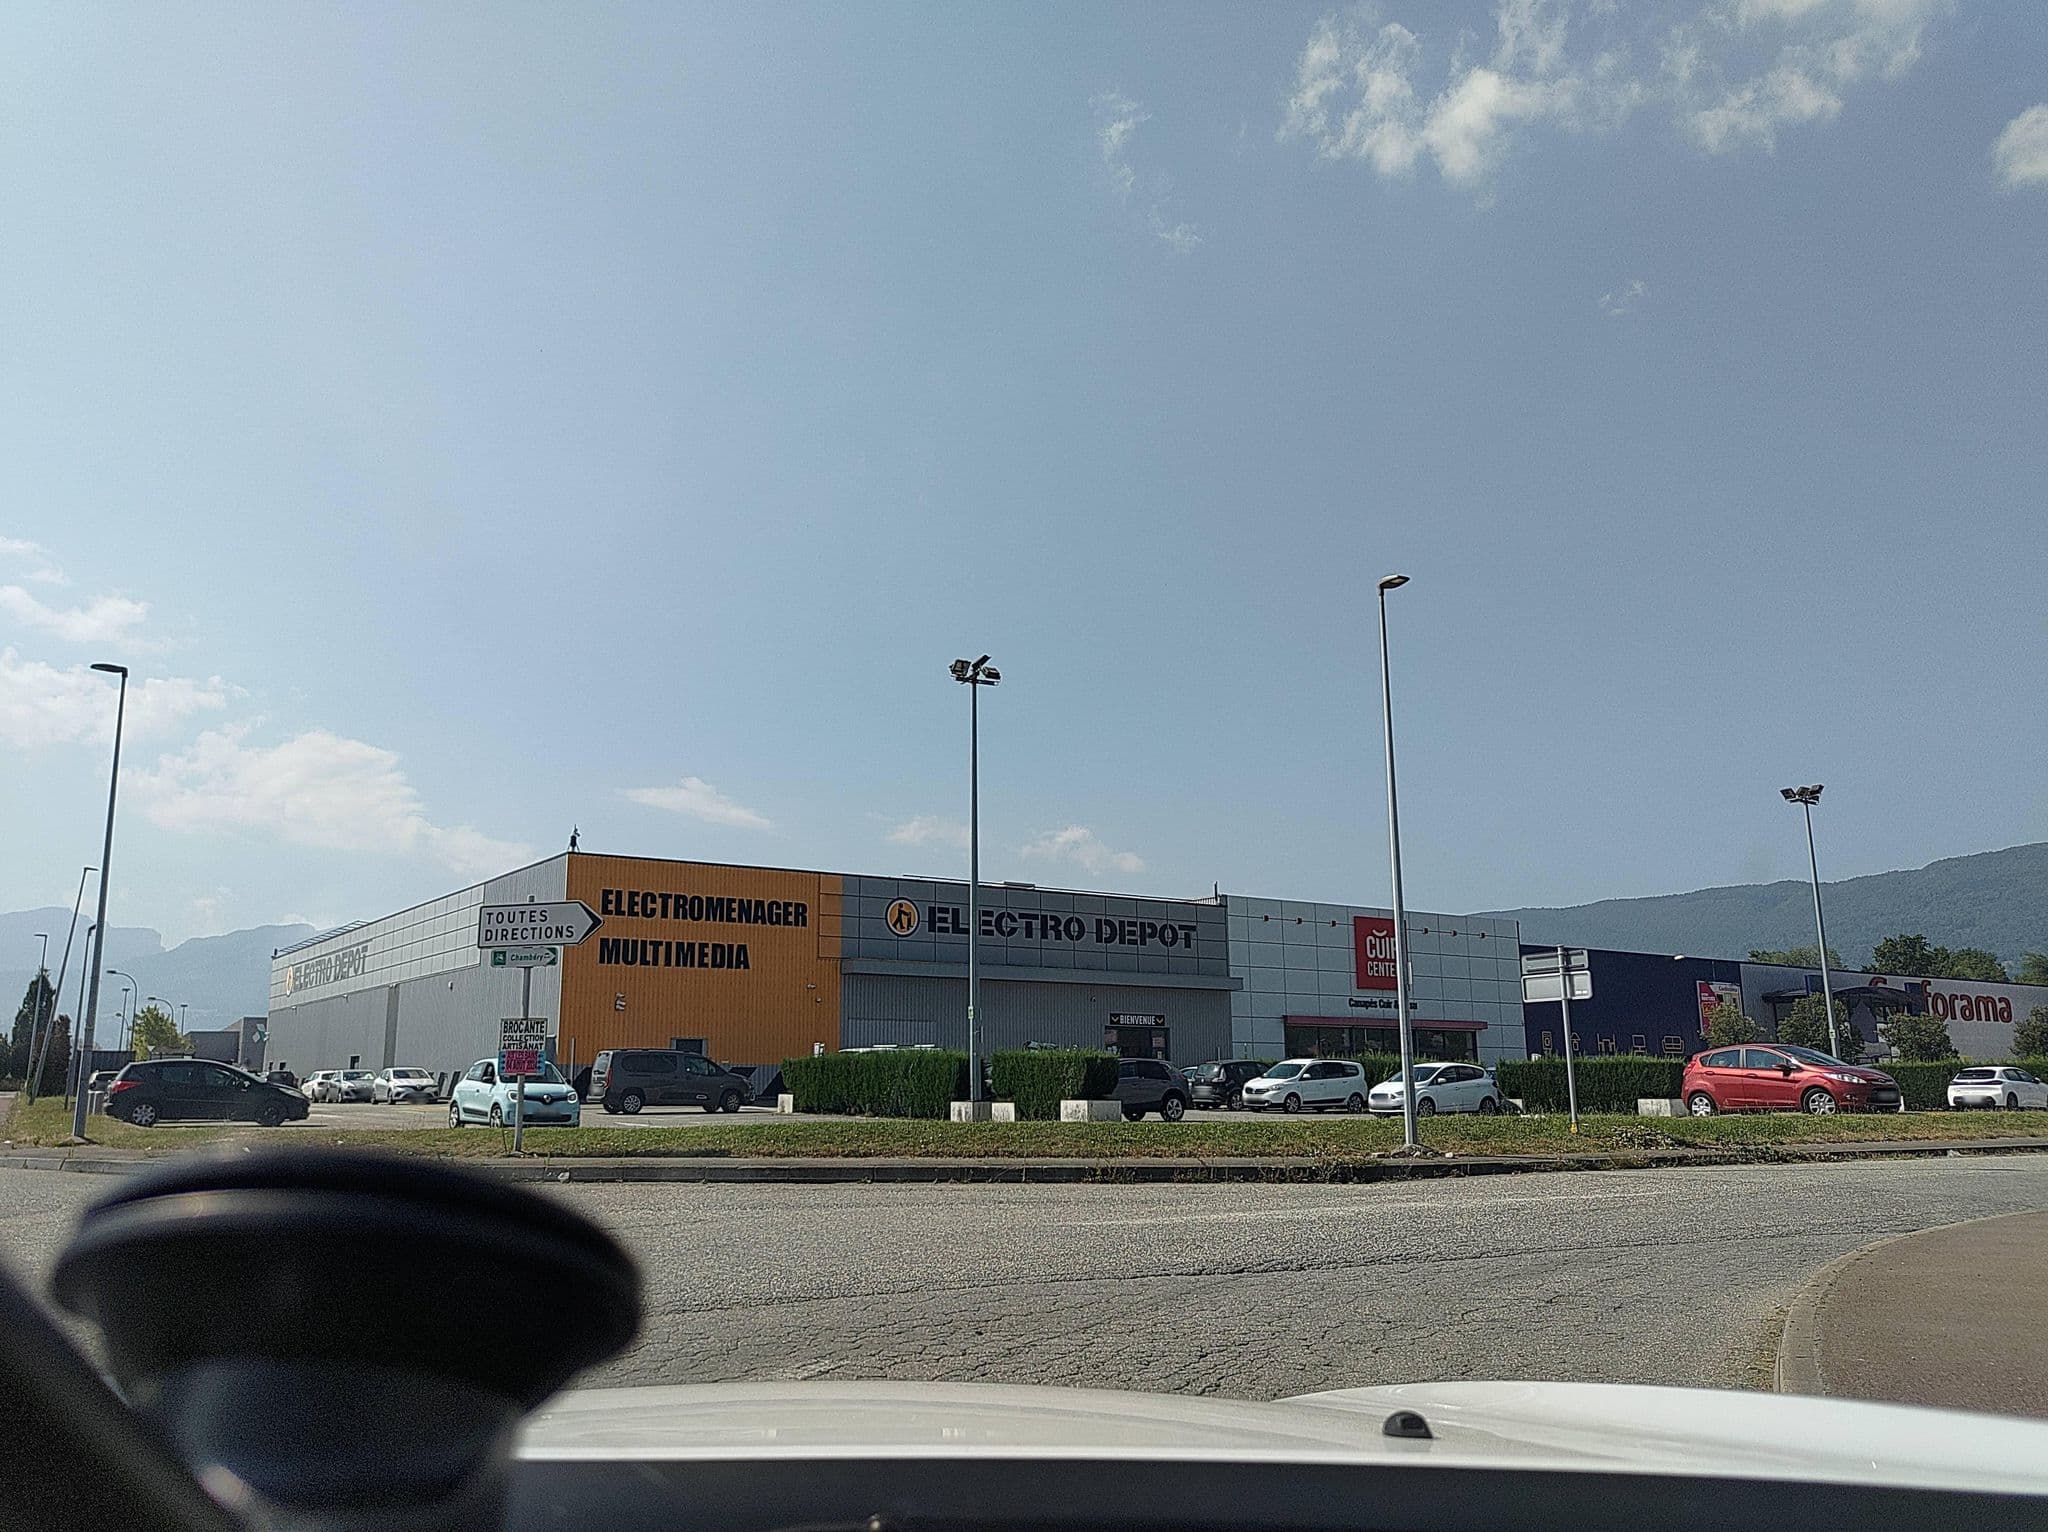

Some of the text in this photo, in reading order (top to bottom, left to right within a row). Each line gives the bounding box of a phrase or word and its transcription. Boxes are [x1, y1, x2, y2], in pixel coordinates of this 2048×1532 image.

[601, 888, 808, 928] ELECTROMENAGER
[486, 909, 549, 925] TOUTES
[485, 925, 575, 942] DIRECTIONS
[927, 905, 1198, 949] ELECTRO DEPOT
[599, 937, 751, 970] MULTIMEDIA
[294, 944, 368, 992] ELECTRO DEPOT
[1367, 961, 1397, 977] CENTE
[1868, 976, 2013, 1024] forama
[503, 1020, 545, 1034] BROCANTE
[1119, 1014, 1156, 1025] BIENVENUE
[502, 1034, 545, 1042] COLLECTION
[502, 1042, 544, 1050] ARTISANAT
